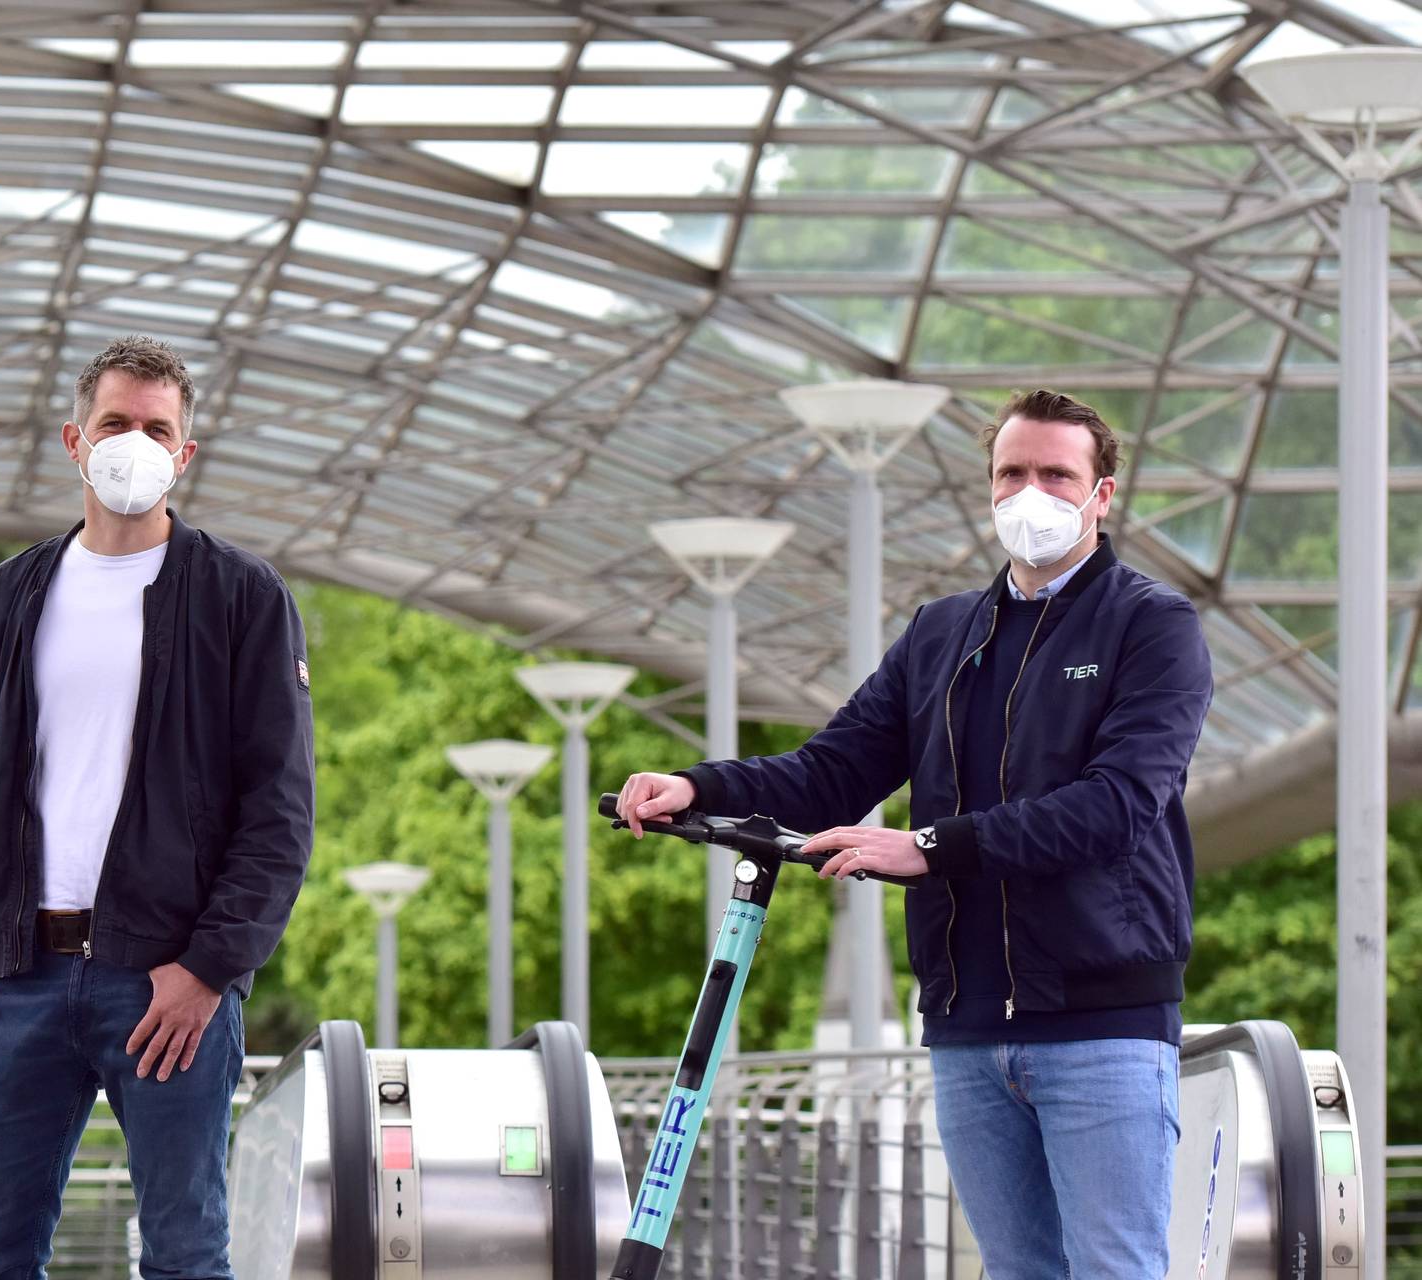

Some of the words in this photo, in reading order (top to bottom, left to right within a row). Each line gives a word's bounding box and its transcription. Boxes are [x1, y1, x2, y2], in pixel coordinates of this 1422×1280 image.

[1063, 664, 1098, 680] TIER
[727, 908, 758, 922] ier.app
[632, 1095, 696, 1228] TIER
